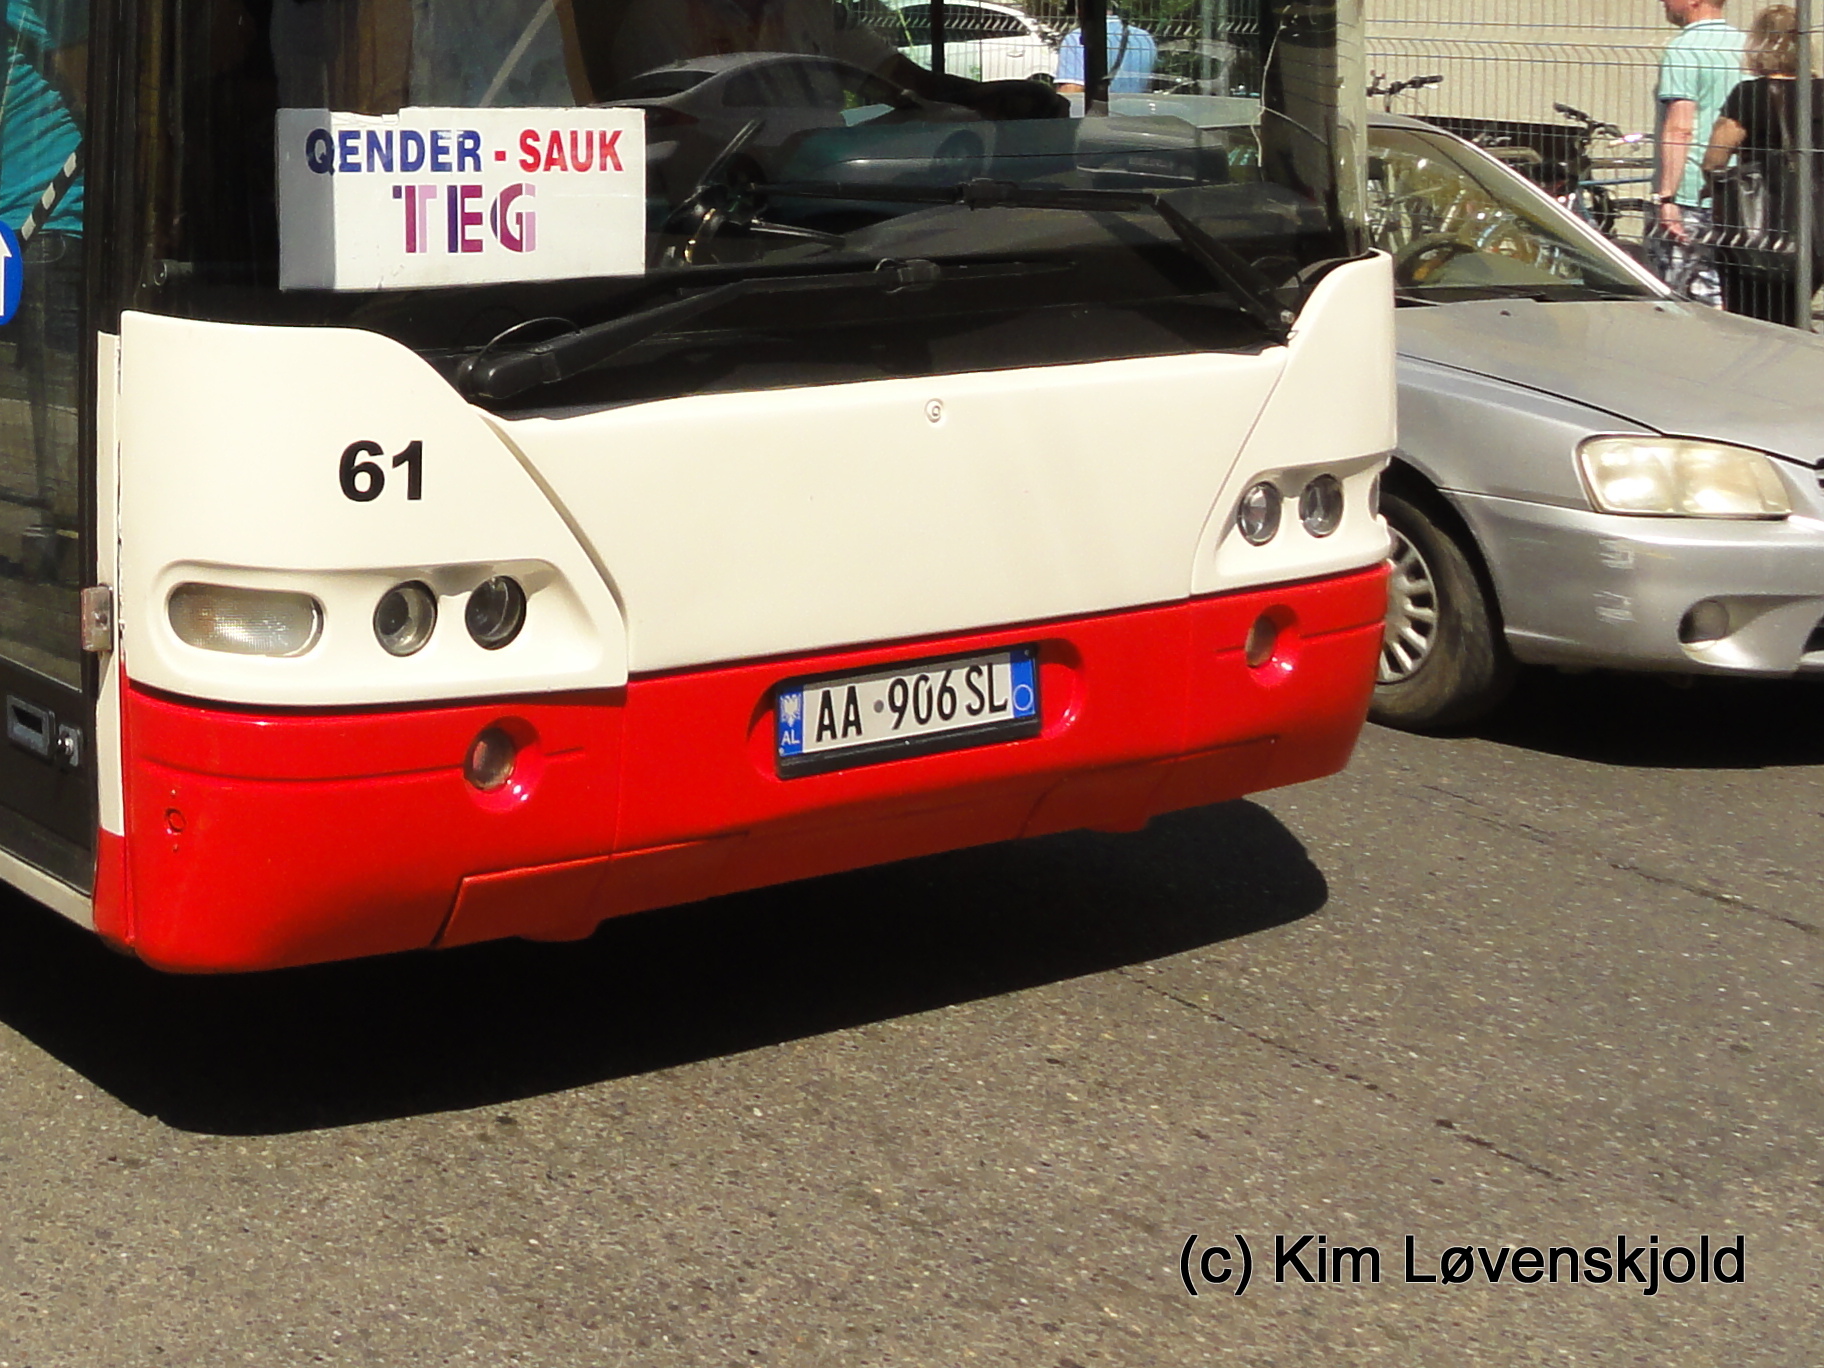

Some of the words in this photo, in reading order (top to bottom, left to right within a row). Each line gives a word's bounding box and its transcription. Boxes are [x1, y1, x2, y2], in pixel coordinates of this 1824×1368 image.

[305, 128, 482, 175] QENDER
[519, 128, 624, 172] SAUK
[392, 182, 536, 253] TEG
[338, 440, 423, 502] 61
[781, 730, 800, 745] AL
[815, 685, 863, 743] AA
